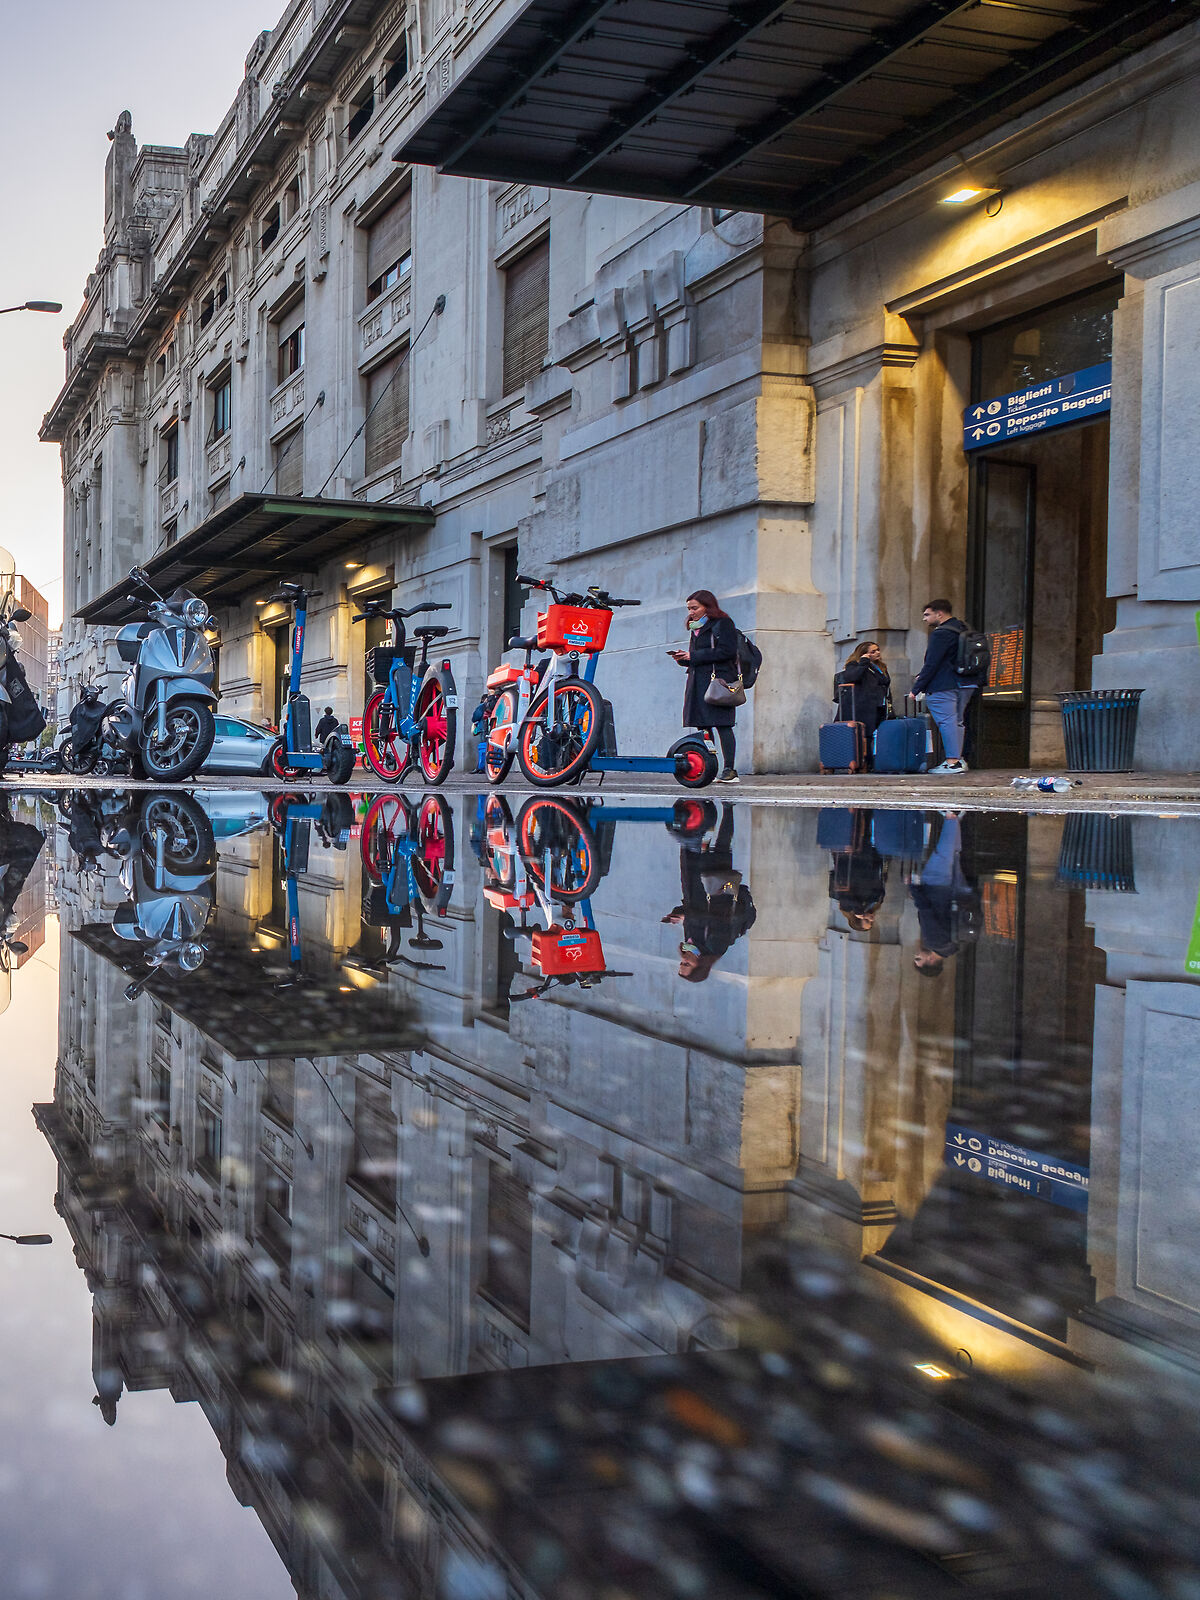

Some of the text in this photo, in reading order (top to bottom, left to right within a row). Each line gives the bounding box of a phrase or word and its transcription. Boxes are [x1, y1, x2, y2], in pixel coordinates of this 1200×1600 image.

[1007, 385, 1052, 406] Biglietti
[1007, 404, 1028, 413] Tickets
[1007, 389, 1111, 428] Deposito Bagagli
[1006, 420, 1047, 436] Left luggage
